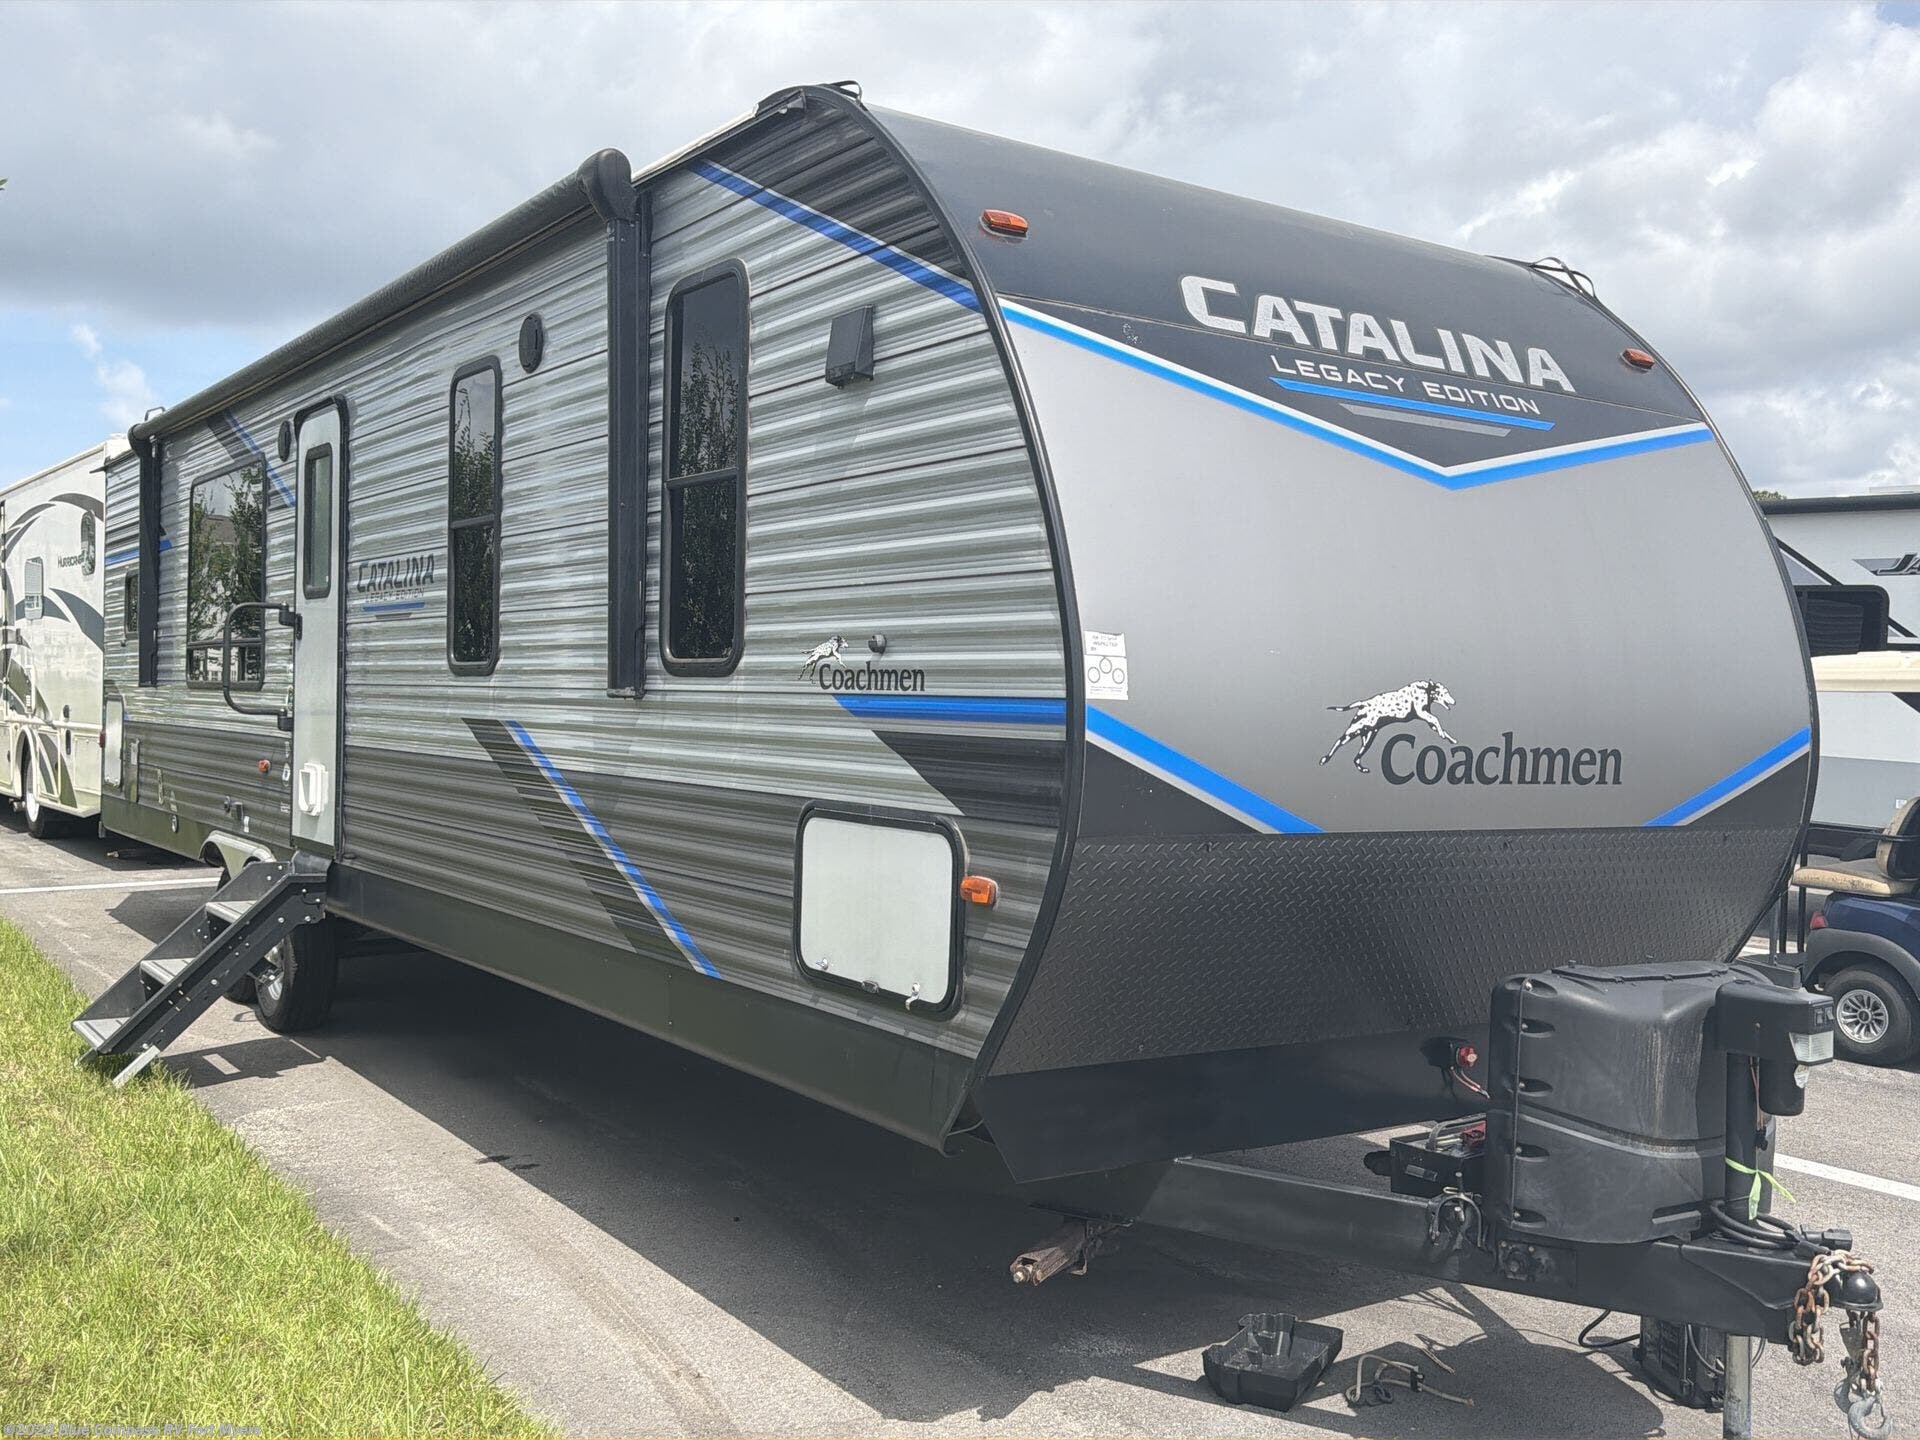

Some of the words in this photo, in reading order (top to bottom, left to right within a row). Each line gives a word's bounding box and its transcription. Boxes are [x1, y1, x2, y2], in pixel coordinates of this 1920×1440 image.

[1180, 274, 1576, 392] CATALINA
[1270, 354, 1405, 393] LEGACY
[1422, 381, 1541, 416] EDITION
[357, 553, 434, 593] CATALINA
[818, 660, 926, 692] Coachmen
[1381, 731, 1622, 785] Coachmen
